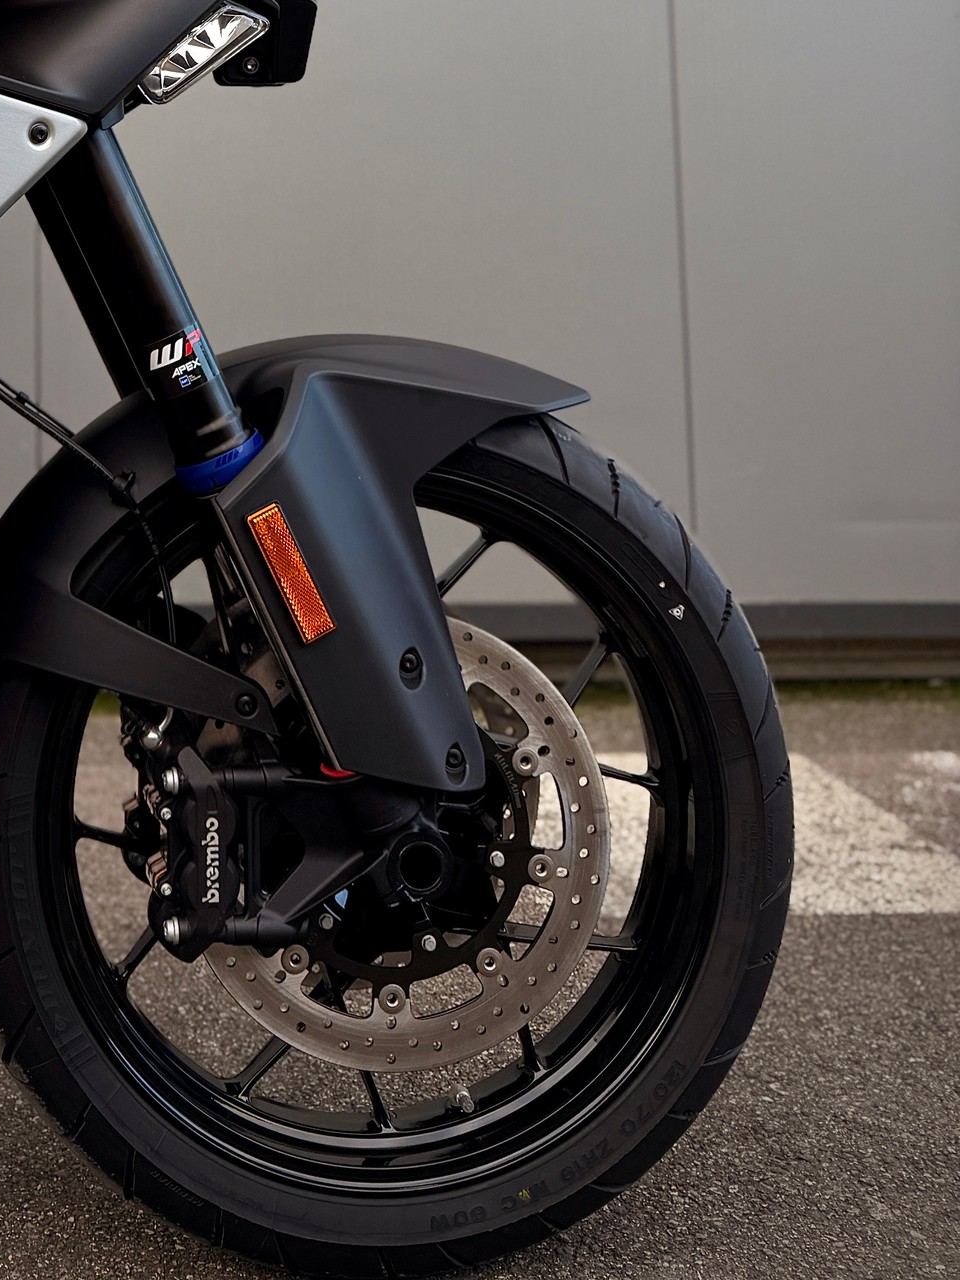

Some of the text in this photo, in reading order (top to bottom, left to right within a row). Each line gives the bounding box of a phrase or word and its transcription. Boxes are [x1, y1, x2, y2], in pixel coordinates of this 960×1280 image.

[150, 328, 202, 371] WP
[172, 357, 202, 379] APEX
[201, 816, 220, 904] brembo
